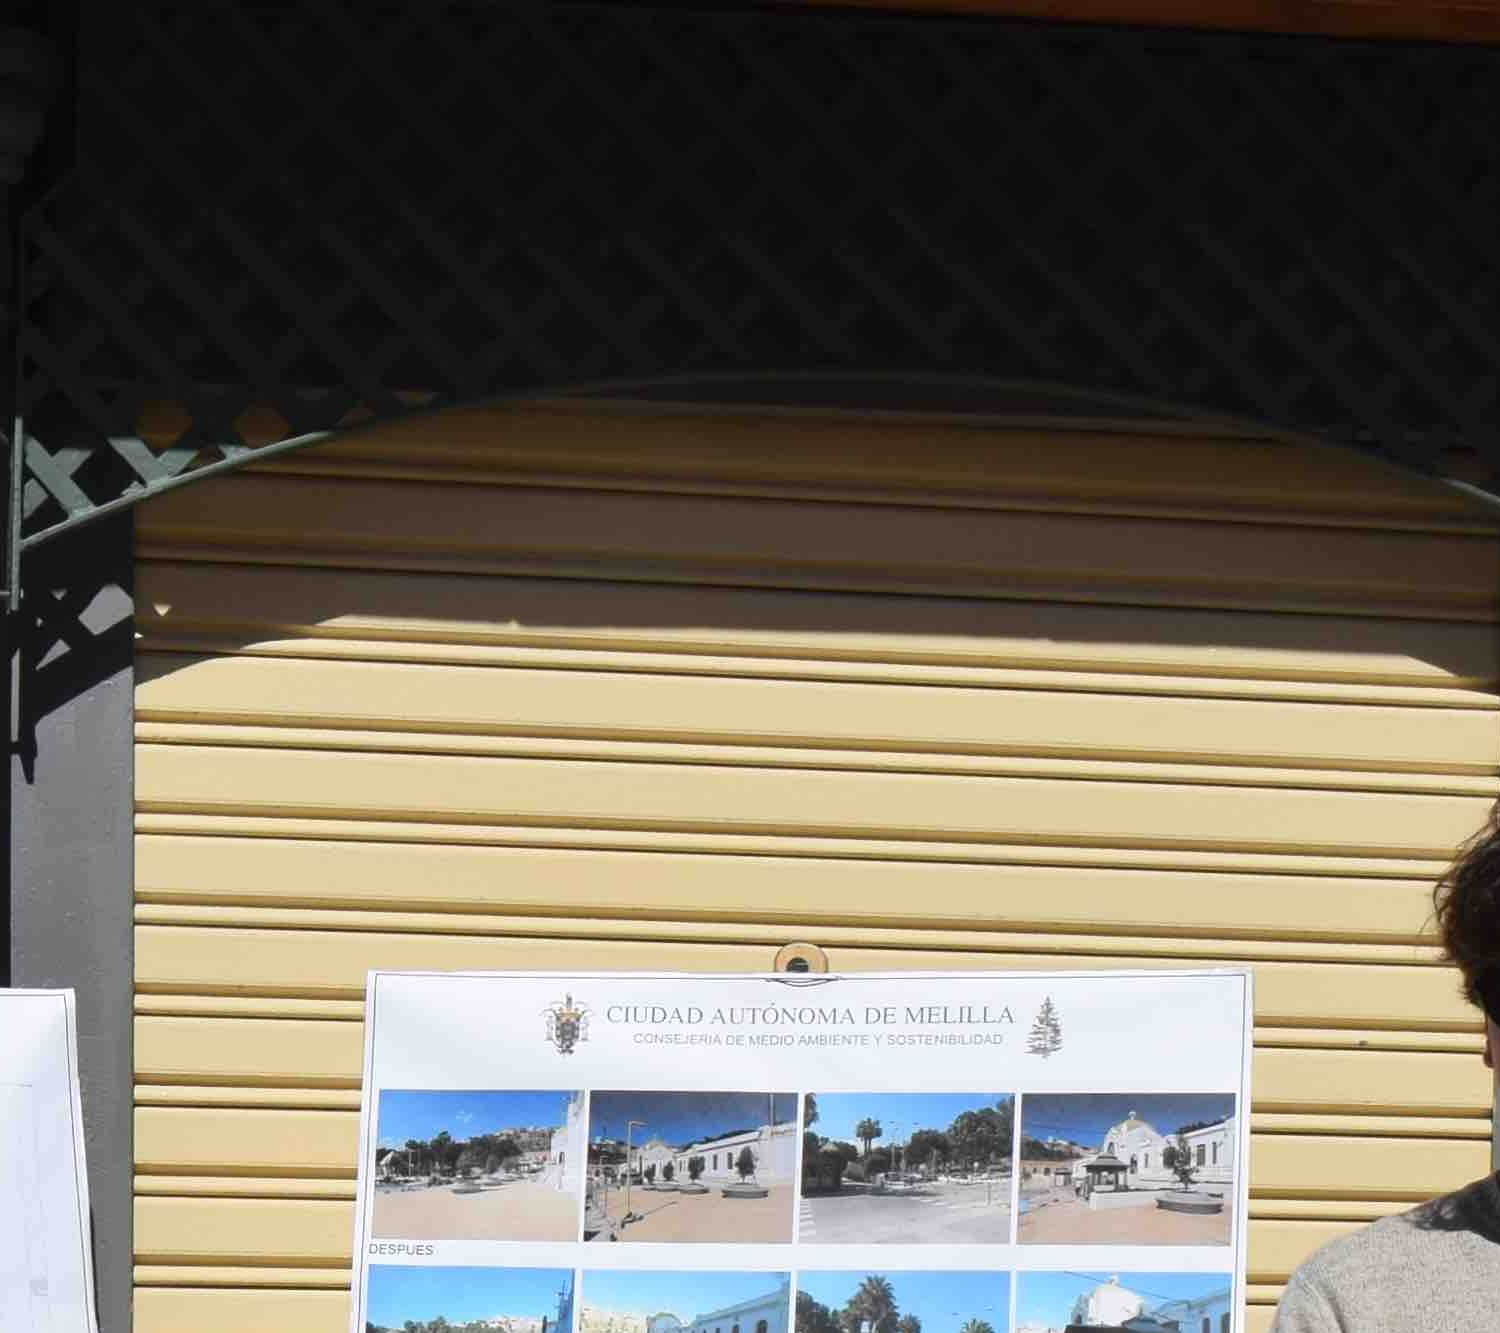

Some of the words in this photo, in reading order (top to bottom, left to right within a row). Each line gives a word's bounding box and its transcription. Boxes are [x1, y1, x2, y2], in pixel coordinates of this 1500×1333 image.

[606, 1006, 704, 1025] CIUDAD
[710, 1002, 856, 1025] AUTÓNOMA
[865, 1006, 897, 1025] DE
[904, 1006, 1015, 1025] MELILLA
[726, 1034, 745, 1046] DE
[749, 1035, 794, 1047] MEDIO
[798, 1034, 868, 1046] AMBIENTE
[873, 1034, 882, 1045] Y
[887, 1033, 1003, 1046] SOSTENIBILIDAD
[368, 1243, 434, 1256] DESPUES
